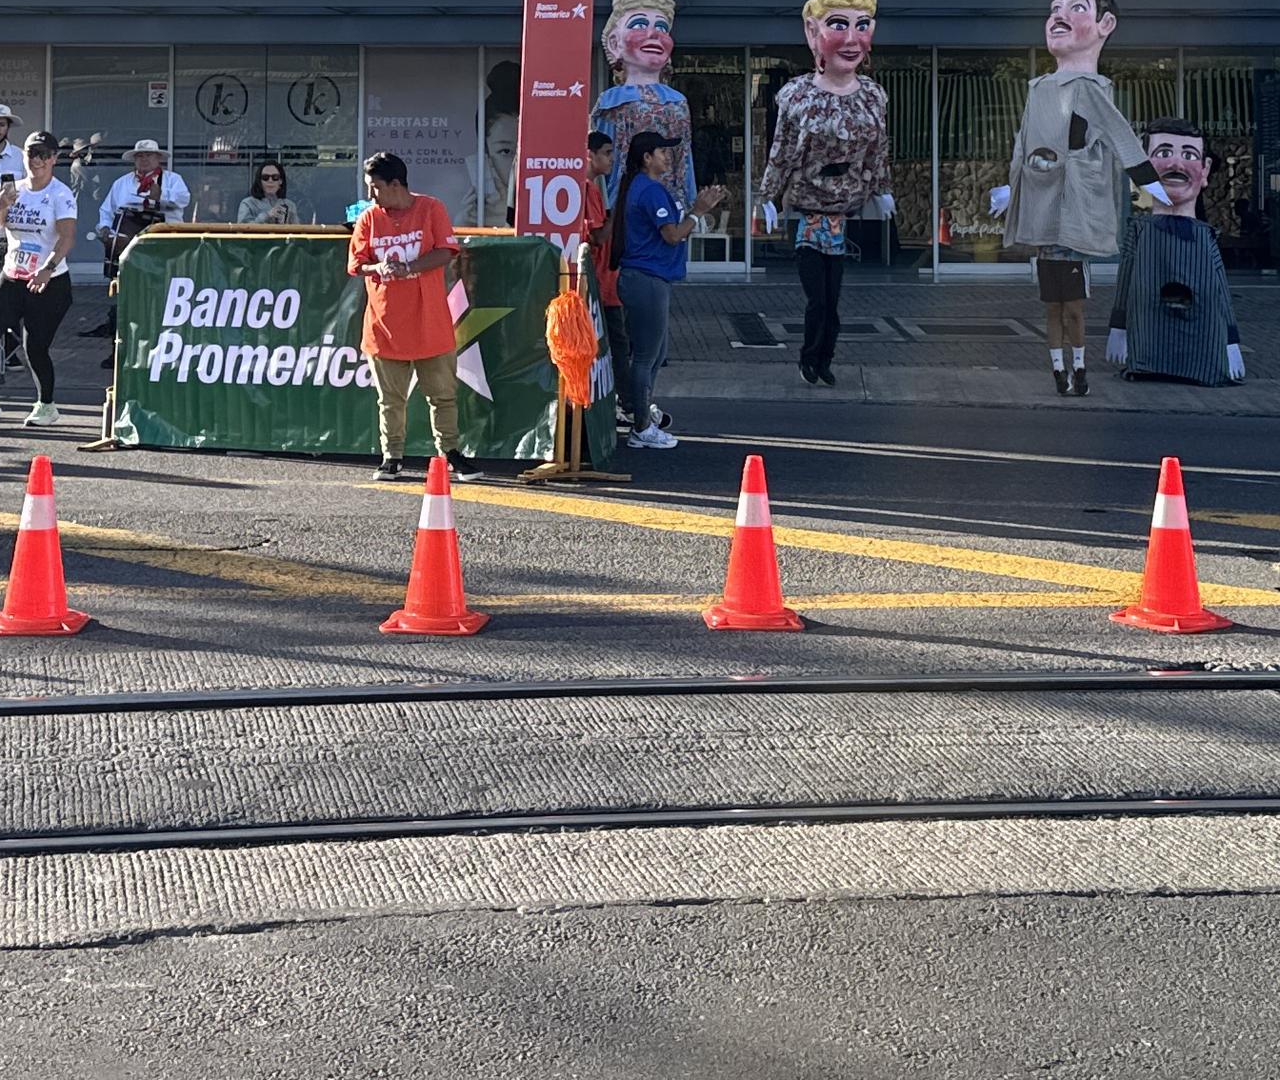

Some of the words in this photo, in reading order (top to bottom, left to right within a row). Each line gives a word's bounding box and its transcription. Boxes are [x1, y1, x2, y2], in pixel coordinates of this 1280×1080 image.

[536, 3, 558, 11] Banco
[534, 10, 570, 19] Promerica
[11, 89, 39, 97] NACE
[531, 88, 567, 97] Promerica
[367, 117, 430, 128] EXPERTAS
[432, 117, 448, 128] EN
[526, 158, 583, 170] RETORNO
[525, 174, 582, 226] 10
[7, 208, 41, 218] ARATÓN
[162, 277, 301, 329] Banco
[148, 332, 377, 388] Promerica
